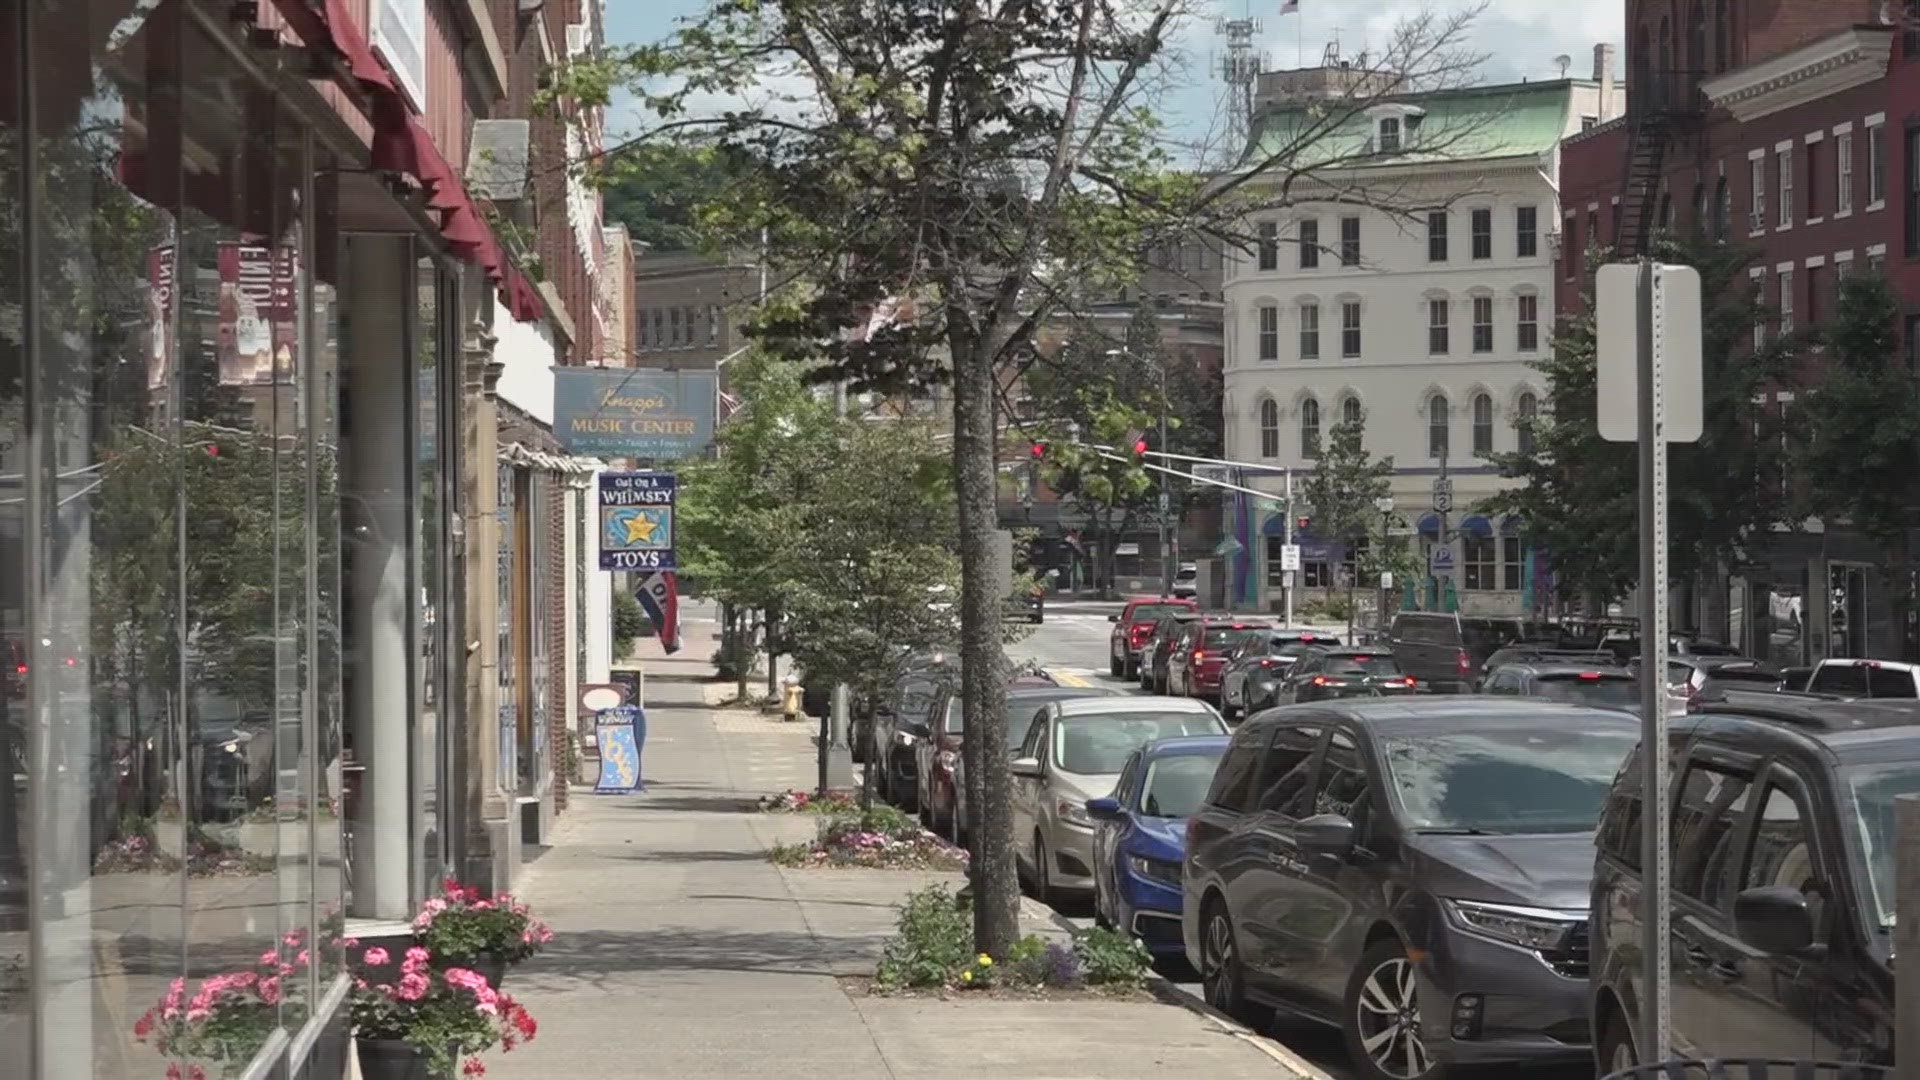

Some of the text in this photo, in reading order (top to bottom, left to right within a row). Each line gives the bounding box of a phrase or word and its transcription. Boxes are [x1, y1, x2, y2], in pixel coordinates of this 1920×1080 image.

[571, 418, 695, 434] MUSIC CENTER
[615, 477, 659, 489] Out On A
[601, 489, 673, 505] WHIMSEY
[1438, 496, 1447, 509] 2
[611, 550, 660, 567] TOYS
